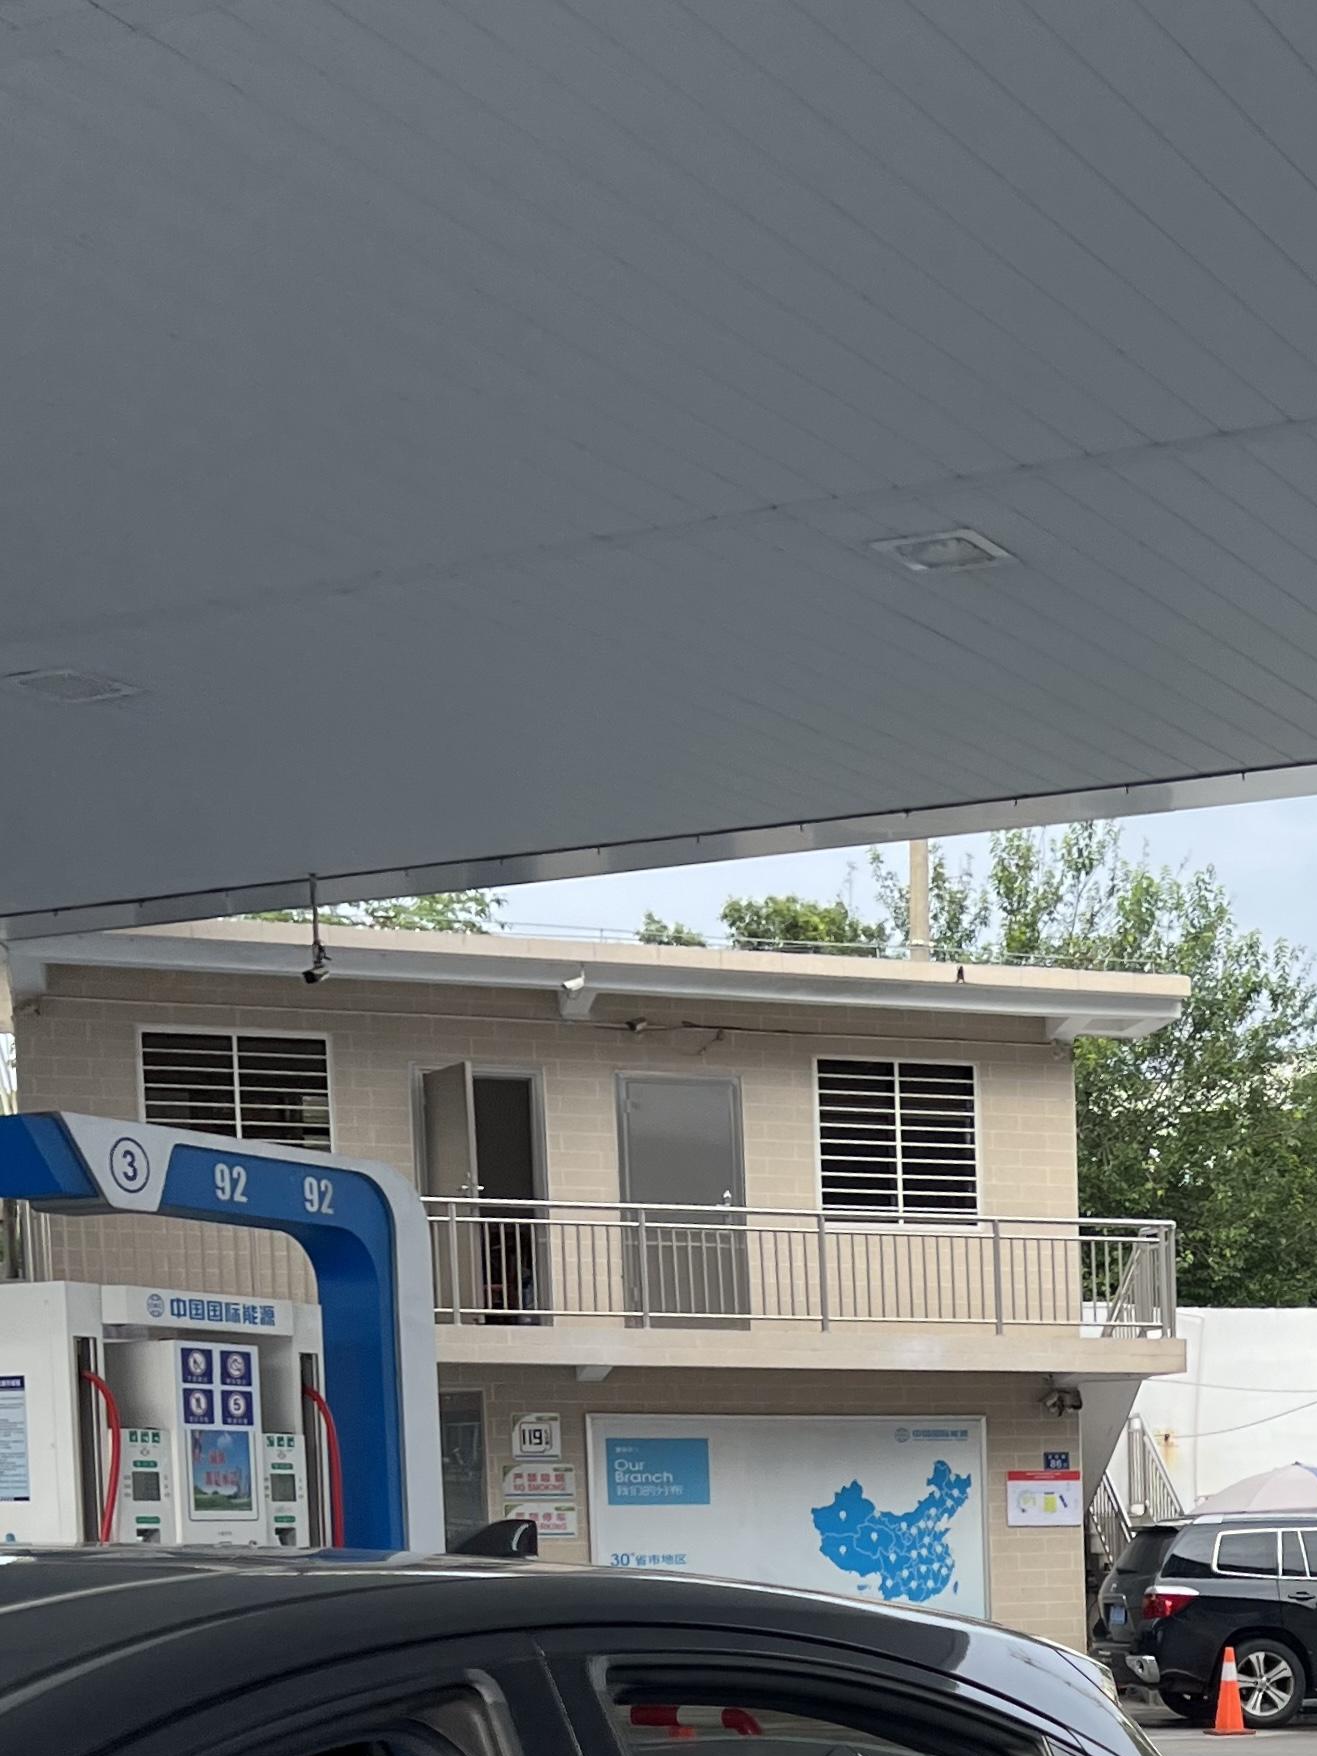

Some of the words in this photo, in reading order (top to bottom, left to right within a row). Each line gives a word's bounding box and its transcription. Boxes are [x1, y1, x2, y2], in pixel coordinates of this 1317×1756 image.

[122, 1150, 138, 1181] 3
[214, 1163, 248, 1203] 92
[303, 1176, 334, 1215] 92
[170, 1298, 275, 1326] 中国国际能源
[522, 1429, 543, 1446] 119
[614, 1459, 645, 1471] Our
[615, 1471, 673, 1482] Branch
